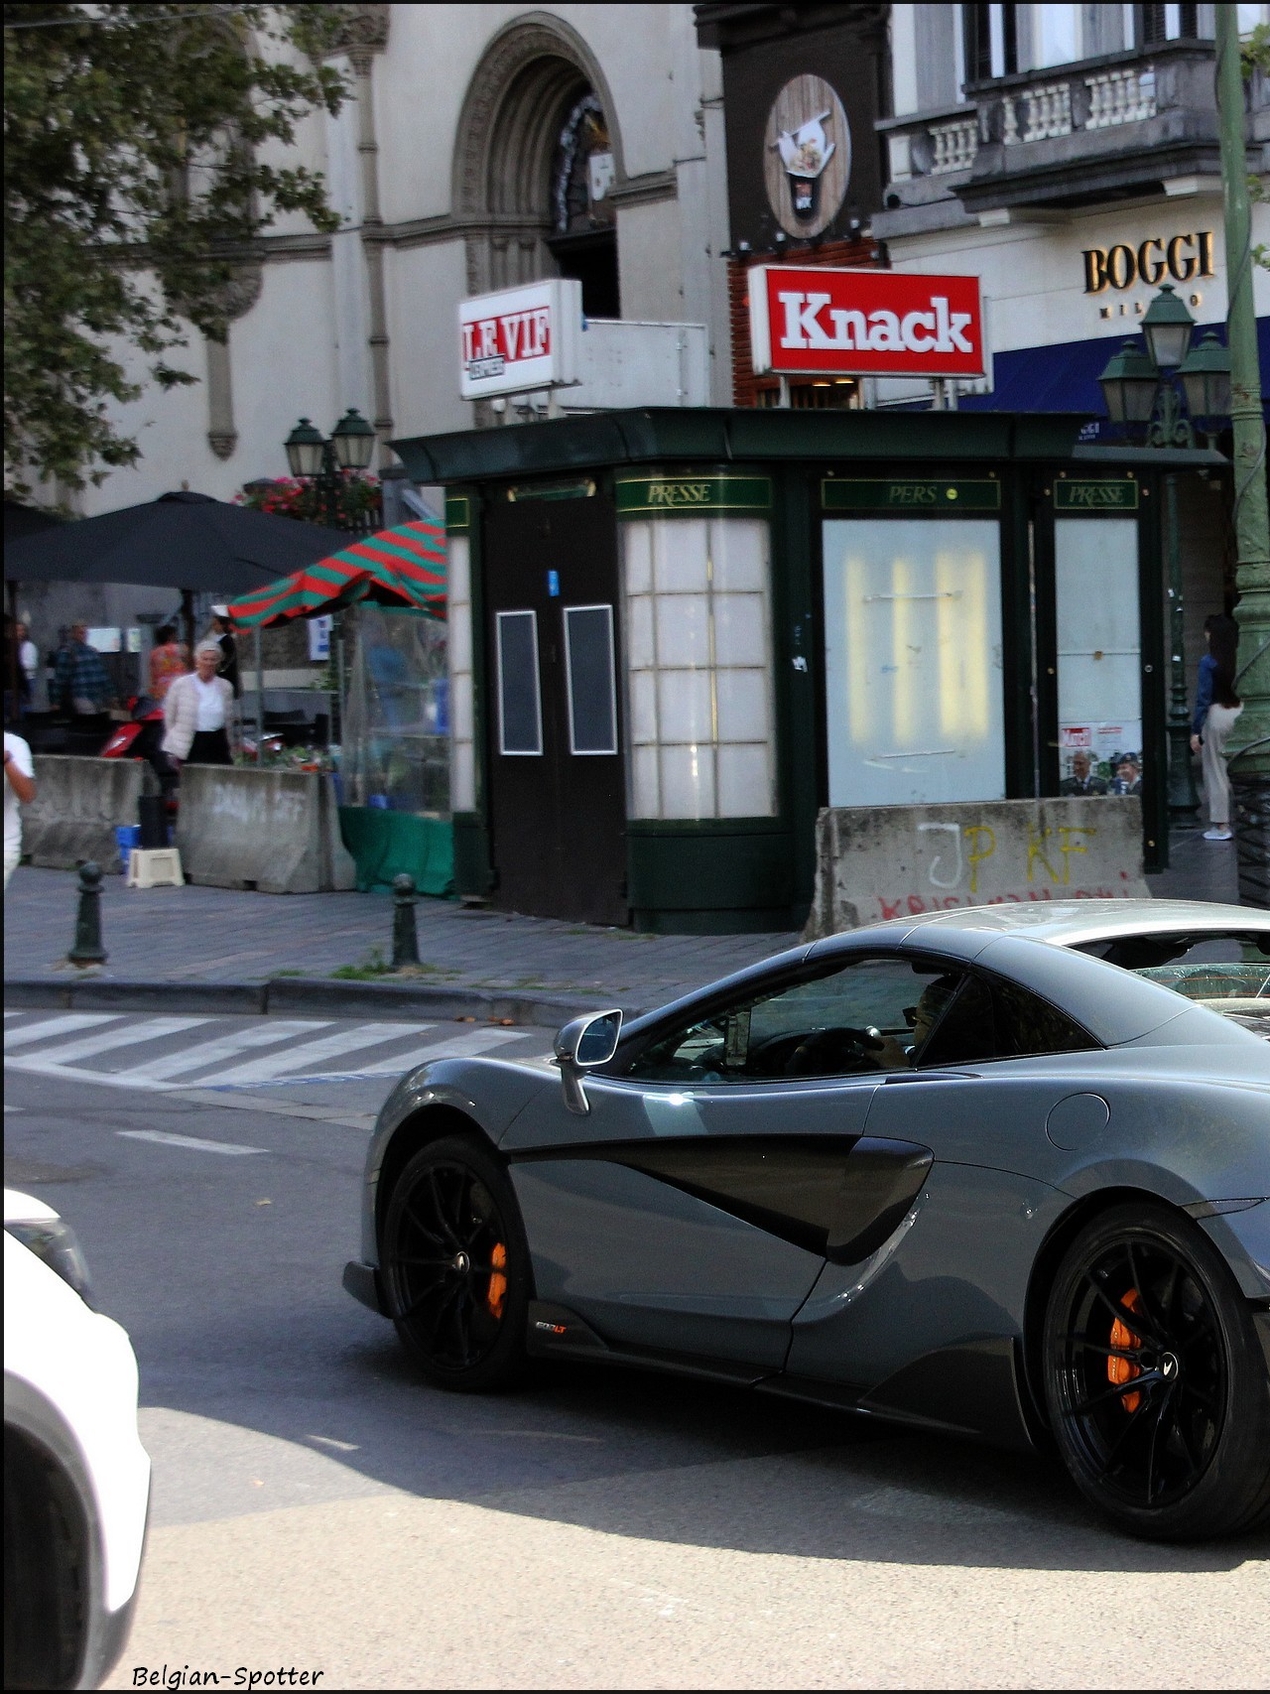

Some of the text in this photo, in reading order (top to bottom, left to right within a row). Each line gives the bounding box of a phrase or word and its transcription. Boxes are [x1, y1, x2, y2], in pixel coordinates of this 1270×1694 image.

[1081, 231, 1215, 294] BOGGI
[1099, 294, 1200, 320] MILO
[778, 291, 973, 353] Knack
[462, 320, 498, 370] LE
[501, 308, 549, 360] VIF
[648, 484, 711, 506] PRESSE
[889, 486, 937, 503] PERS
[1070, 486, 1127, 507] PRESSE
